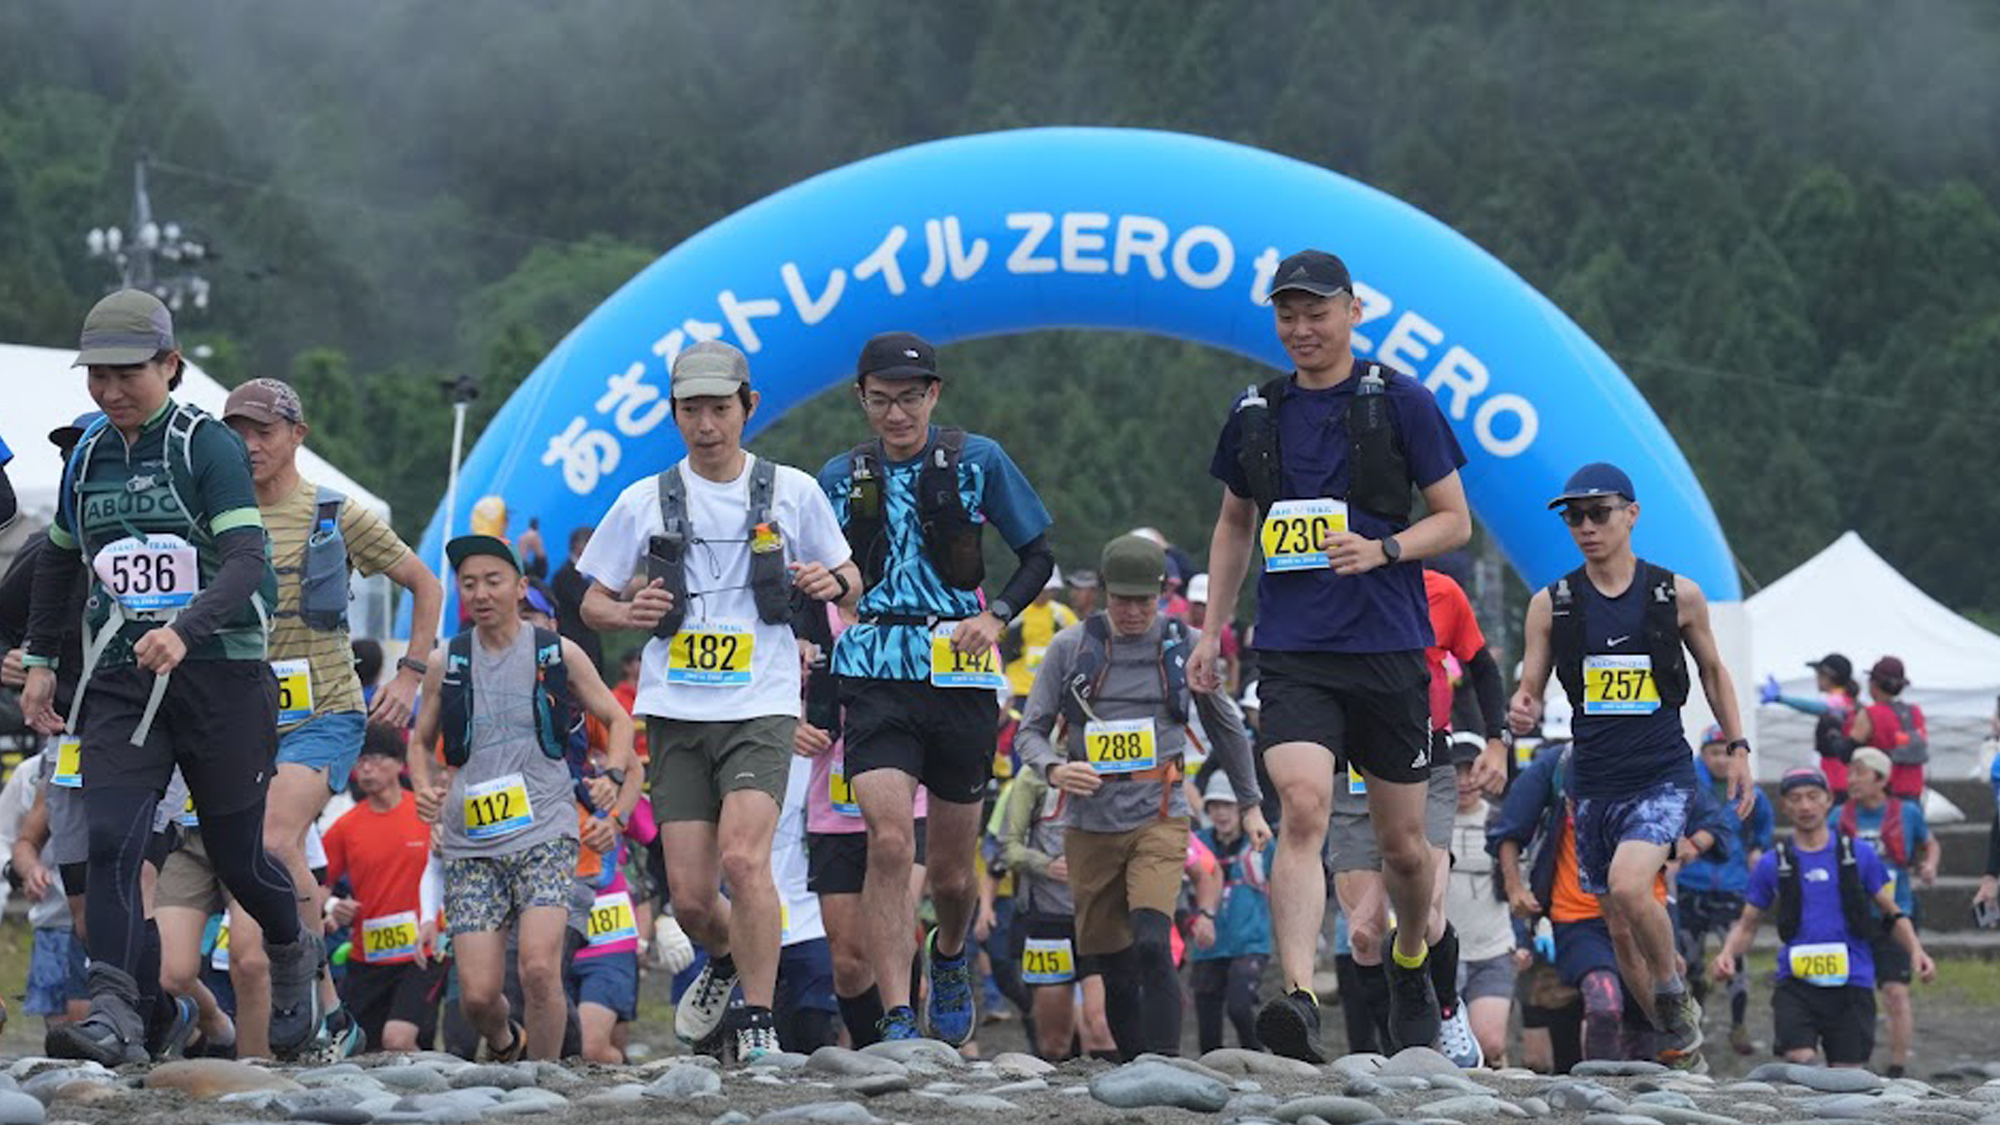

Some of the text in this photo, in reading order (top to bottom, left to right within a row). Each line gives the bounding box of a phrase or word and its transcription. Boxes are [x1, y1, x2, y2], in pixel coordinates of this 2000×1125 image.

[1006, 212, 1234, 290] ZERO
[1250, 246, 1280, 307] t
[85, 492, 181, 520] ABUDO
[1273, 517, 1329, 554] 230
[113, 554, 175, 595] 536
[684, 634, 737, 670] 182
[1601, 670, 1646, 700] 257
[1097, 733, 1142, 761] 288
[471, 791, 514, 826] 112
[590, 906, 620, 935] 187
[371, 925, 409, 951] 285
[1026, 950, 1060, 973] 215
[1801, 954, 1838, 976] 266
